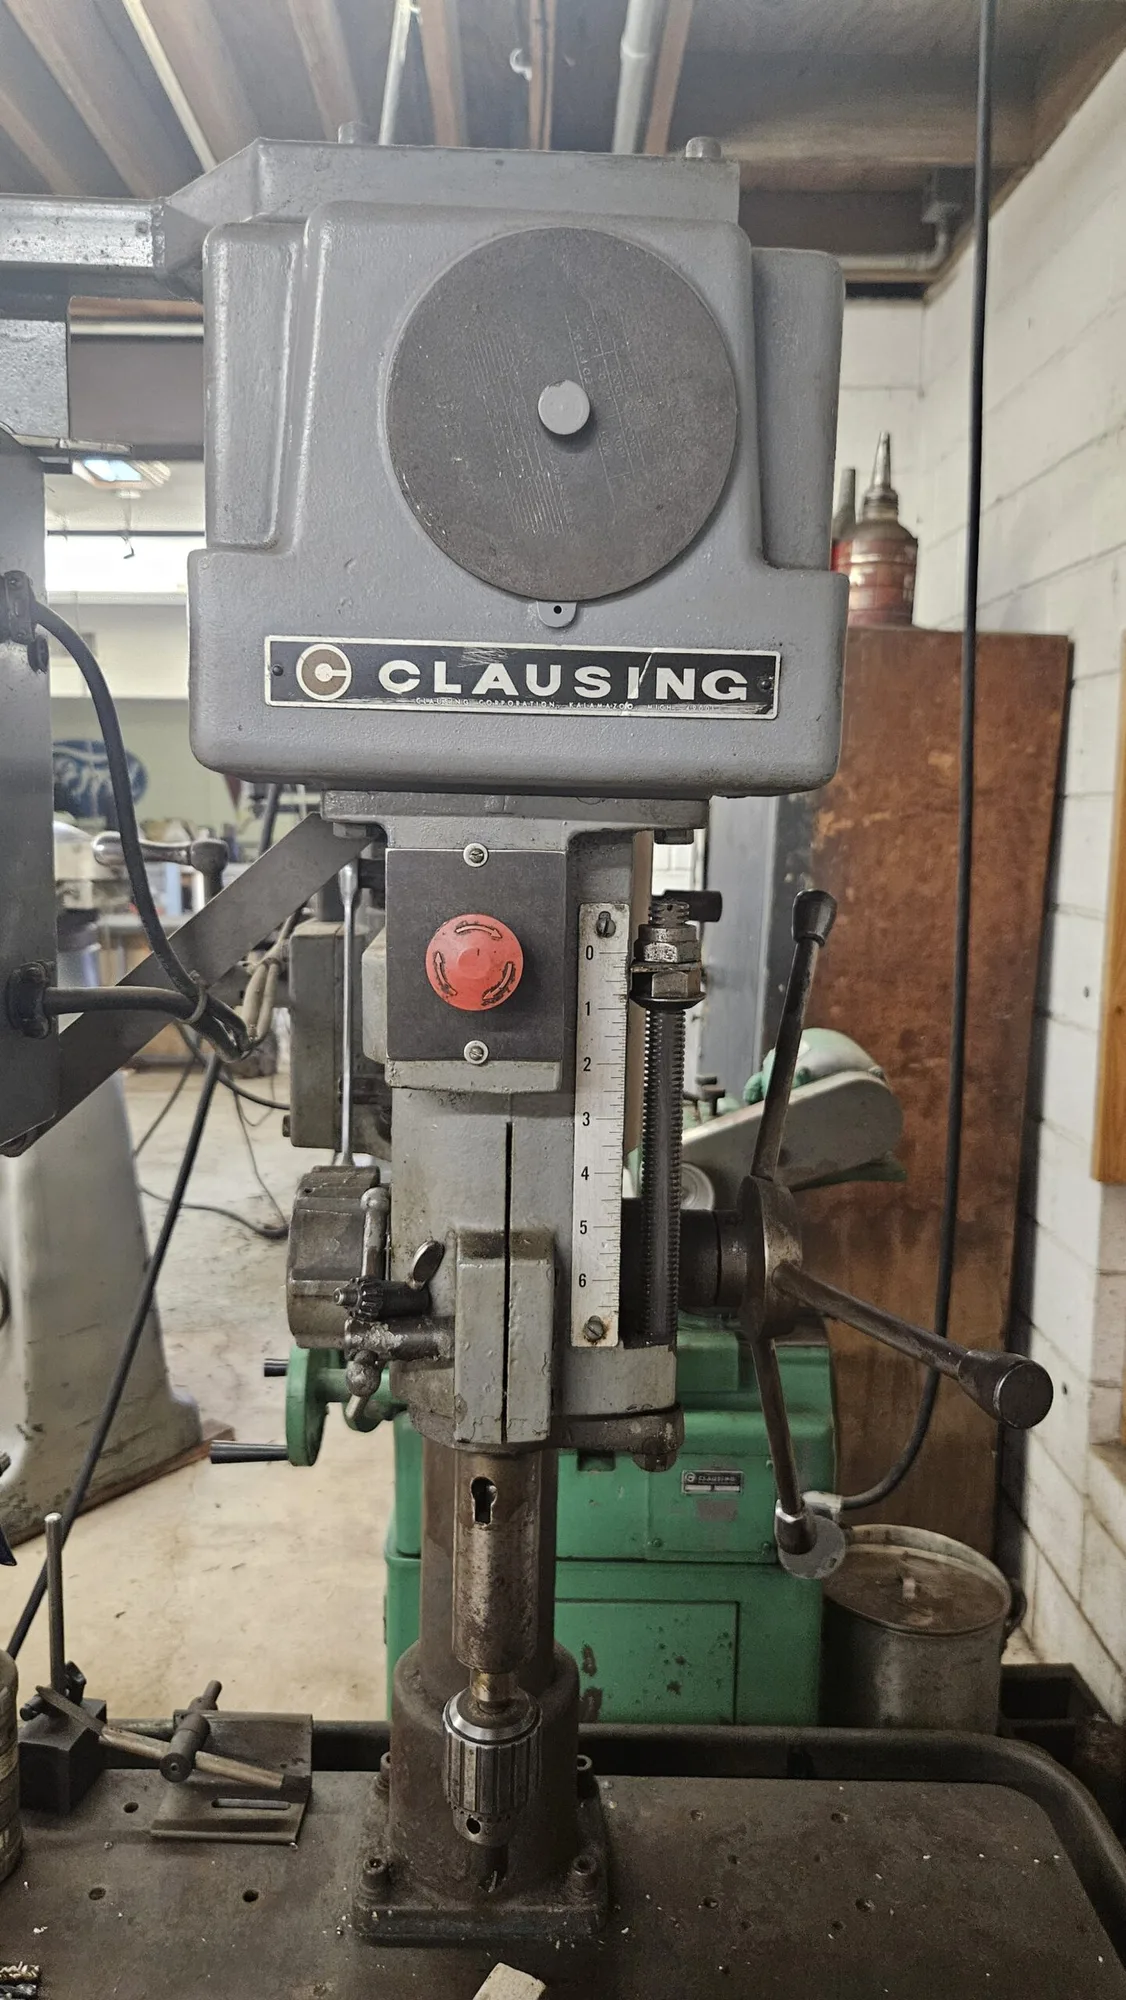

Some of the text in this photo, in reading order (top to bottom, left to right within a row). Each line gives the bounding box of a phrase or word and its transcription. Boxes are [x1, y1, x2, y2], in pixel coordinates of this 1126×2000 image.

[379, 660, 748, 701] CLAUSING
[585, 944, 594, 961] 0
[585, 1001, 591, 1017] 1
[583, 1056, 591, 1072] 2
[582, 1111, 590, 1127] 3
[581, 1166, 589, 1181] 4
[579, 1220, 588, 1235] 5
[578, 1273, 587, 1288] 6
